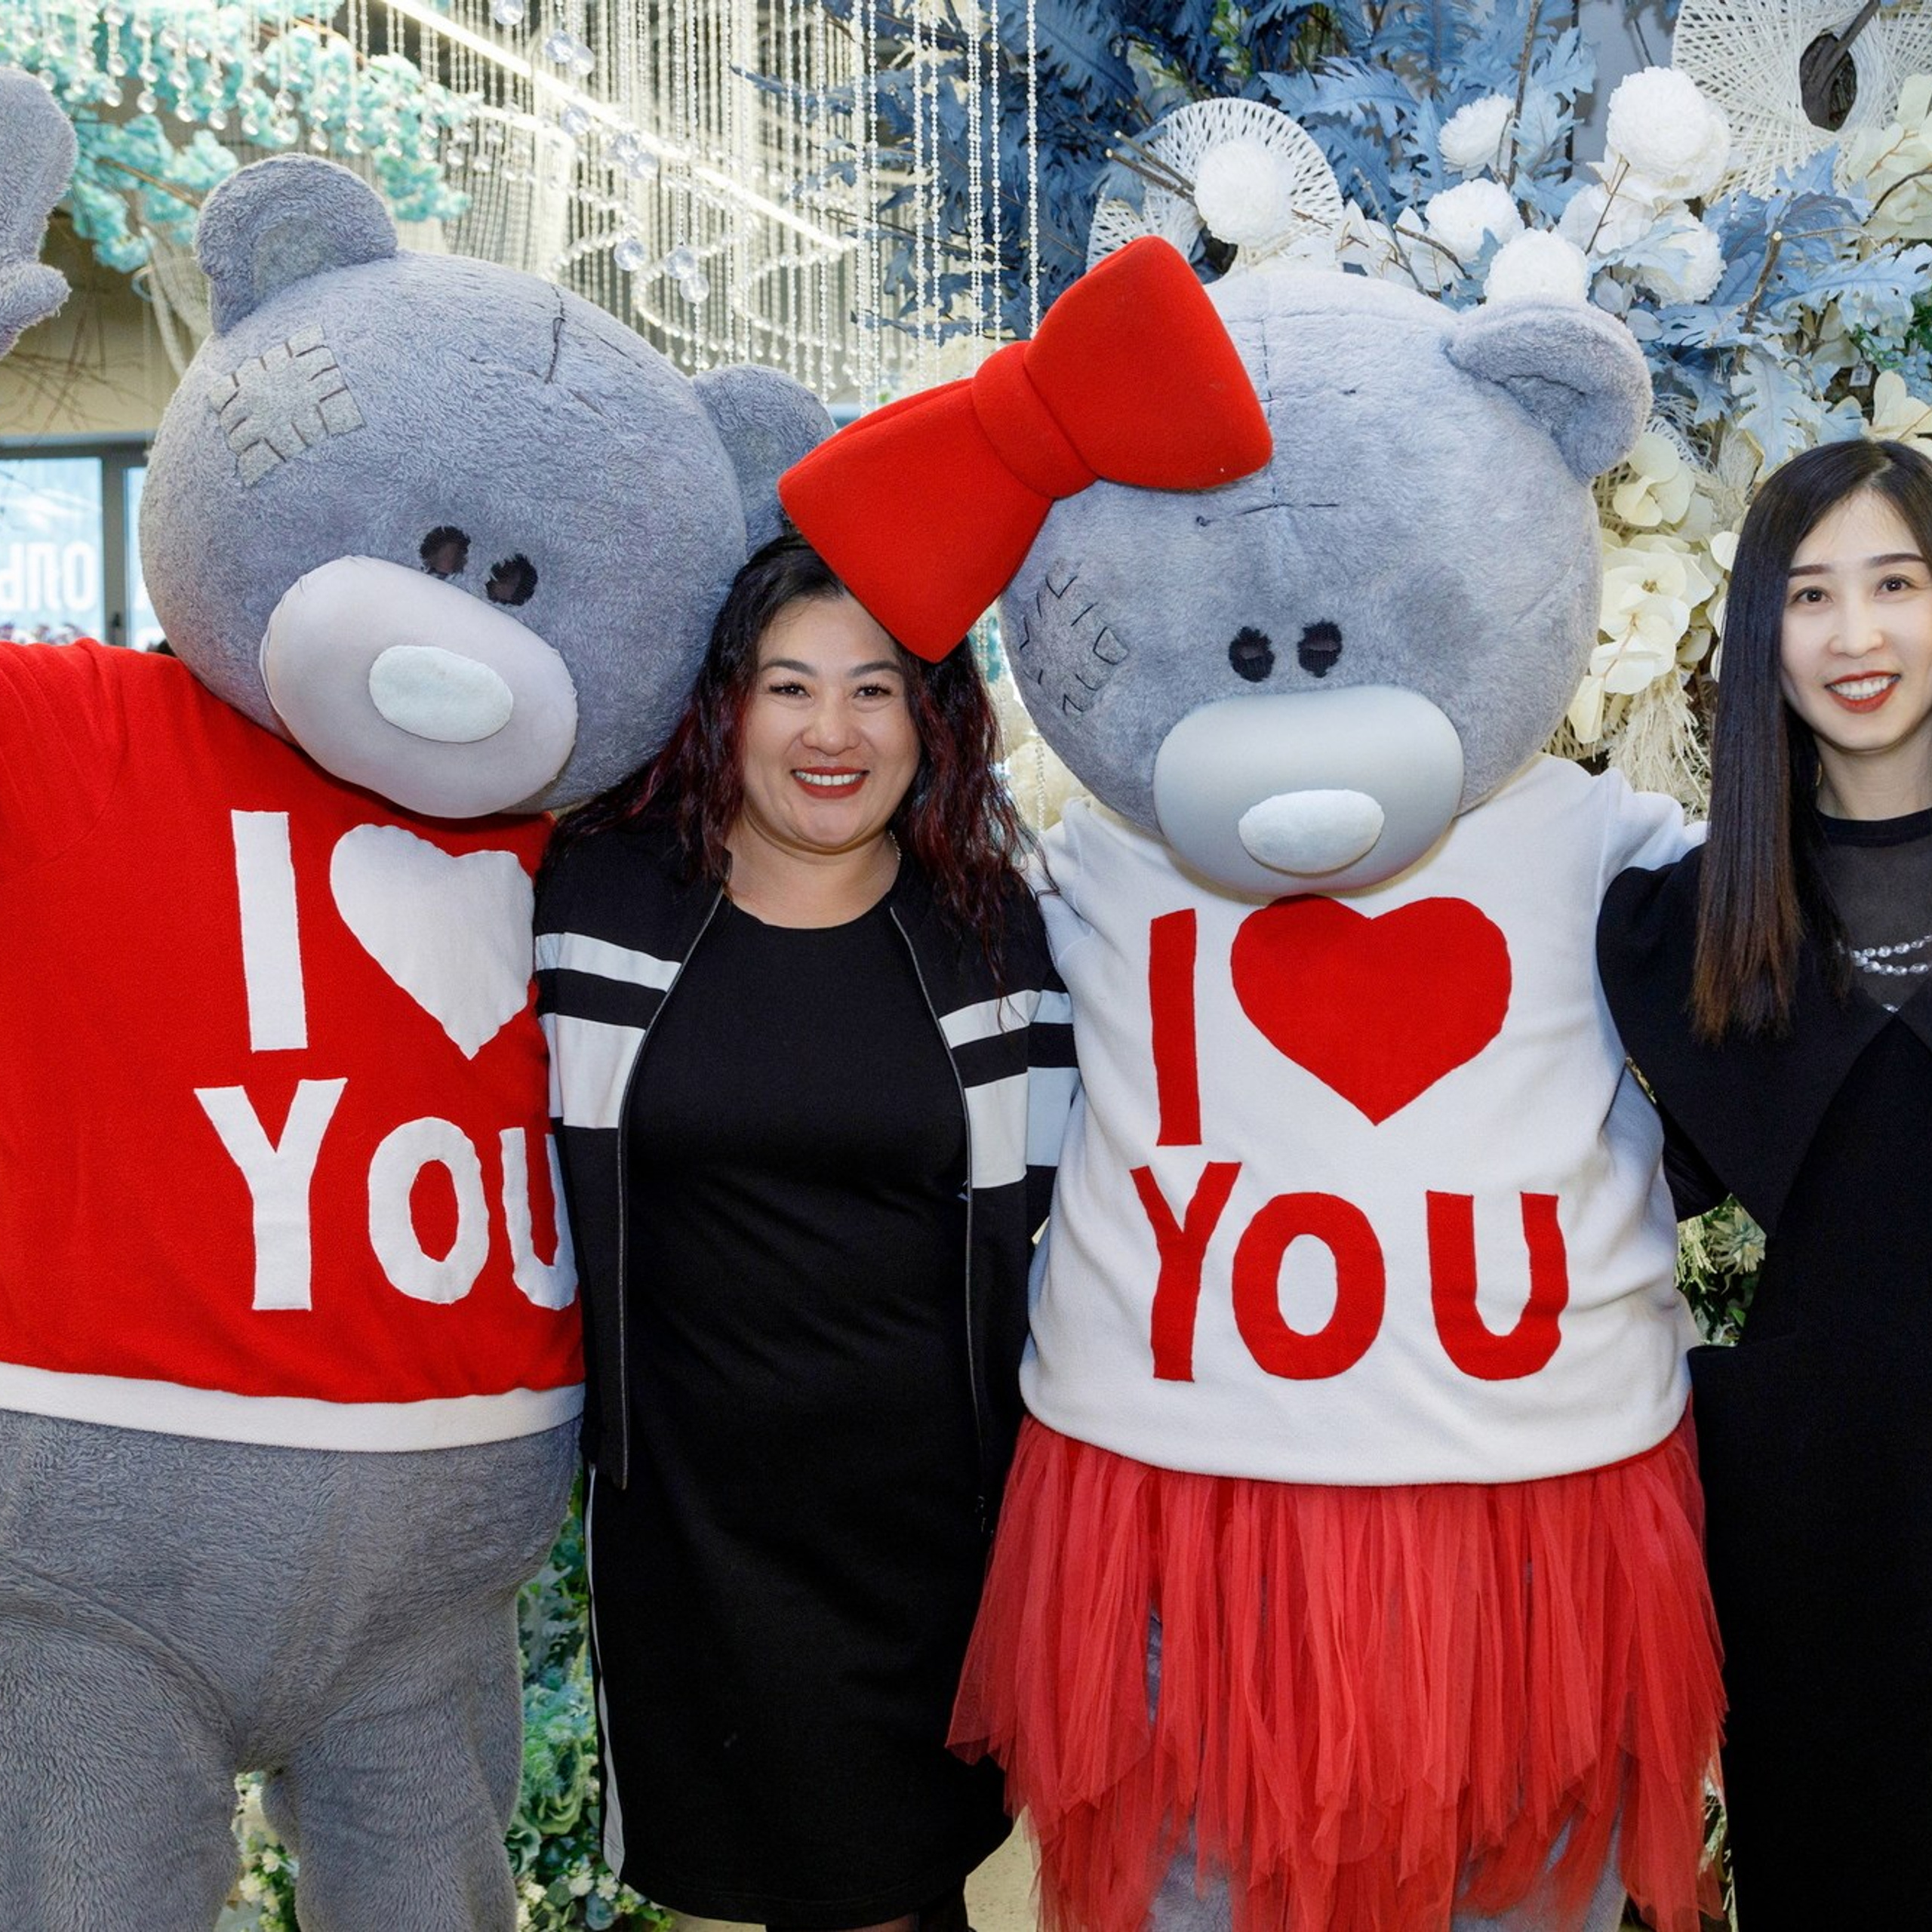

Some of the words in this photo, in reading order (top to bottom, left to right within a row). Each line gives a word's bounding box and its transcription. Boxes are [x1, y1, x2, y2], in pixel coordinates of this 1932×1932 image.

[231, 809, 307, 1053] I
[1149, 908, 1201, 1146] I
[193, 1077, 579, 1311] YOU
[1129, 1161, 1568, 1382] YOU
